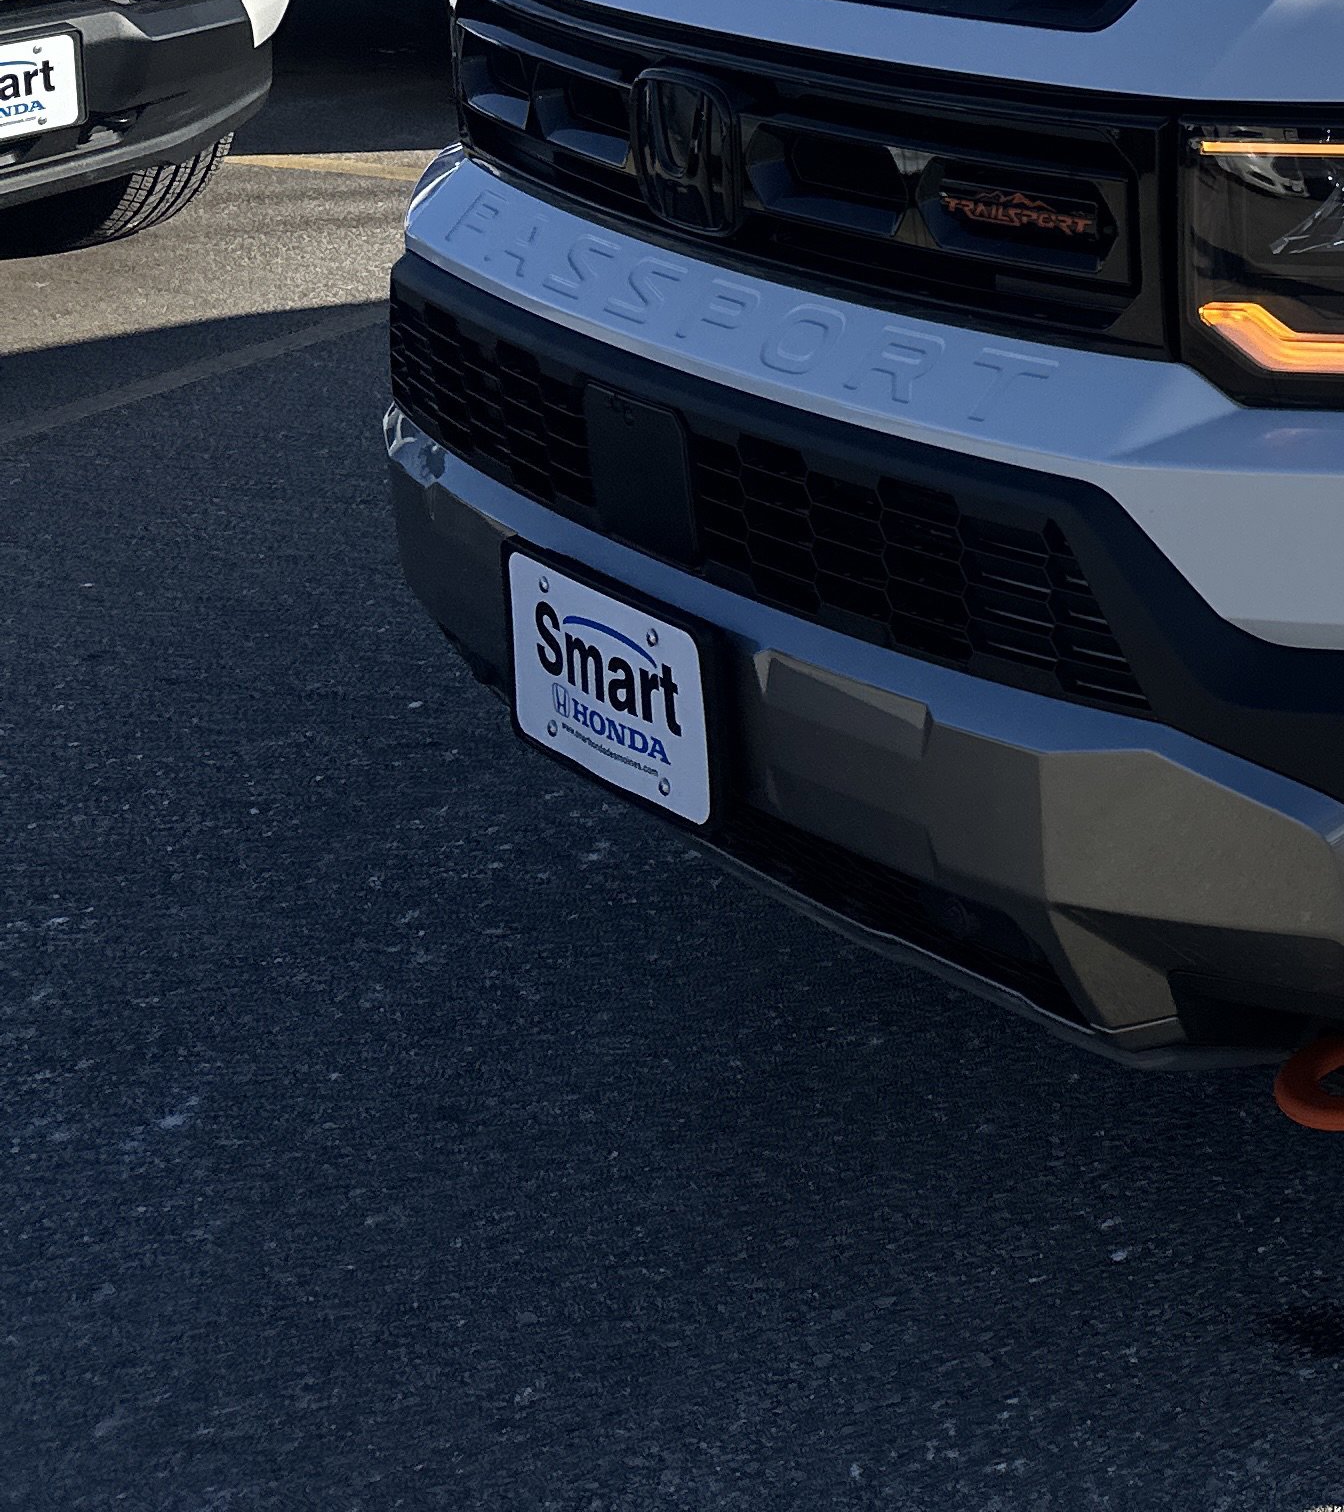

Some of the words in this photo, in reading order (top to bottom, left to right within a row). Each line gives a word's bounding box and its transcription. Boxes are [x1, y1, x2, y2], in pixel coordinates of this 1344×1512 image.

[0, 60, 55, 101] art
[0, 100, 46, 118] NDA
[943, 197, 1093, 236] TRAILSPORT
[446, 190, 1061, 422] PASSPORT
[535, 600, 682, 737] Smart
[572, 697, 672, 766] HONDA
